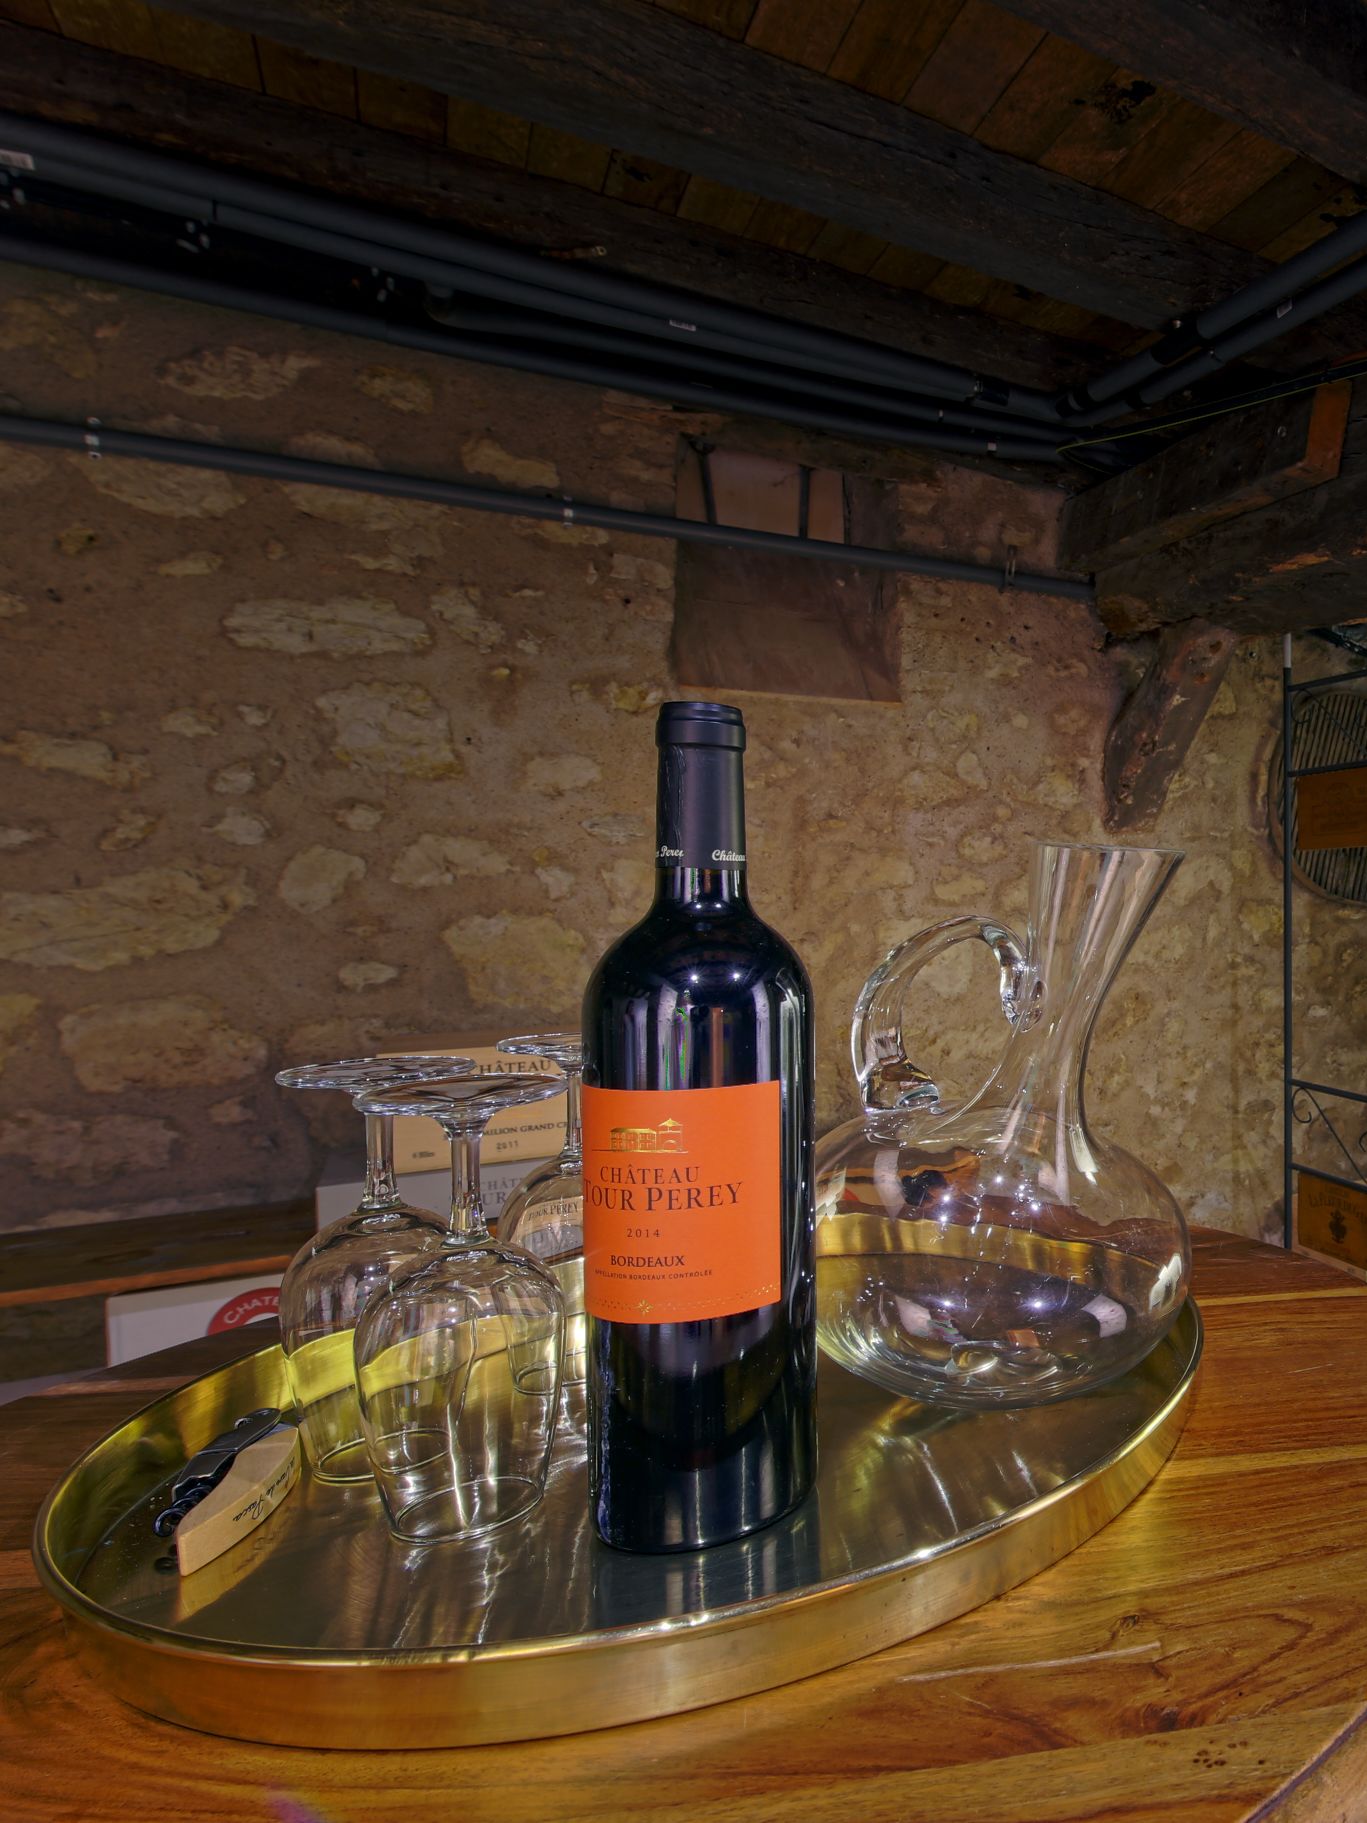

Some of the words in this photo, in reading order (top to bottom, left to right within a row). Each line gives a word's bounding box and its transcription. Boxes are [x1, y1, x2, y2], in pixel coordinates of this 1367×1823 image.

[520, 1122, 554, 1133] GRAND
[600, 1163, 700, 1185] CHÂTEAU
[584, 1178, 636, 1211] TOUR
[645, 1181, 744, 1212] PEREY
[627, 1228, 662, 1239] 2014
[610, 1254, 685, 1268] BORDEAUX
[629, 1273, 666, 1281] BORDEAUX
